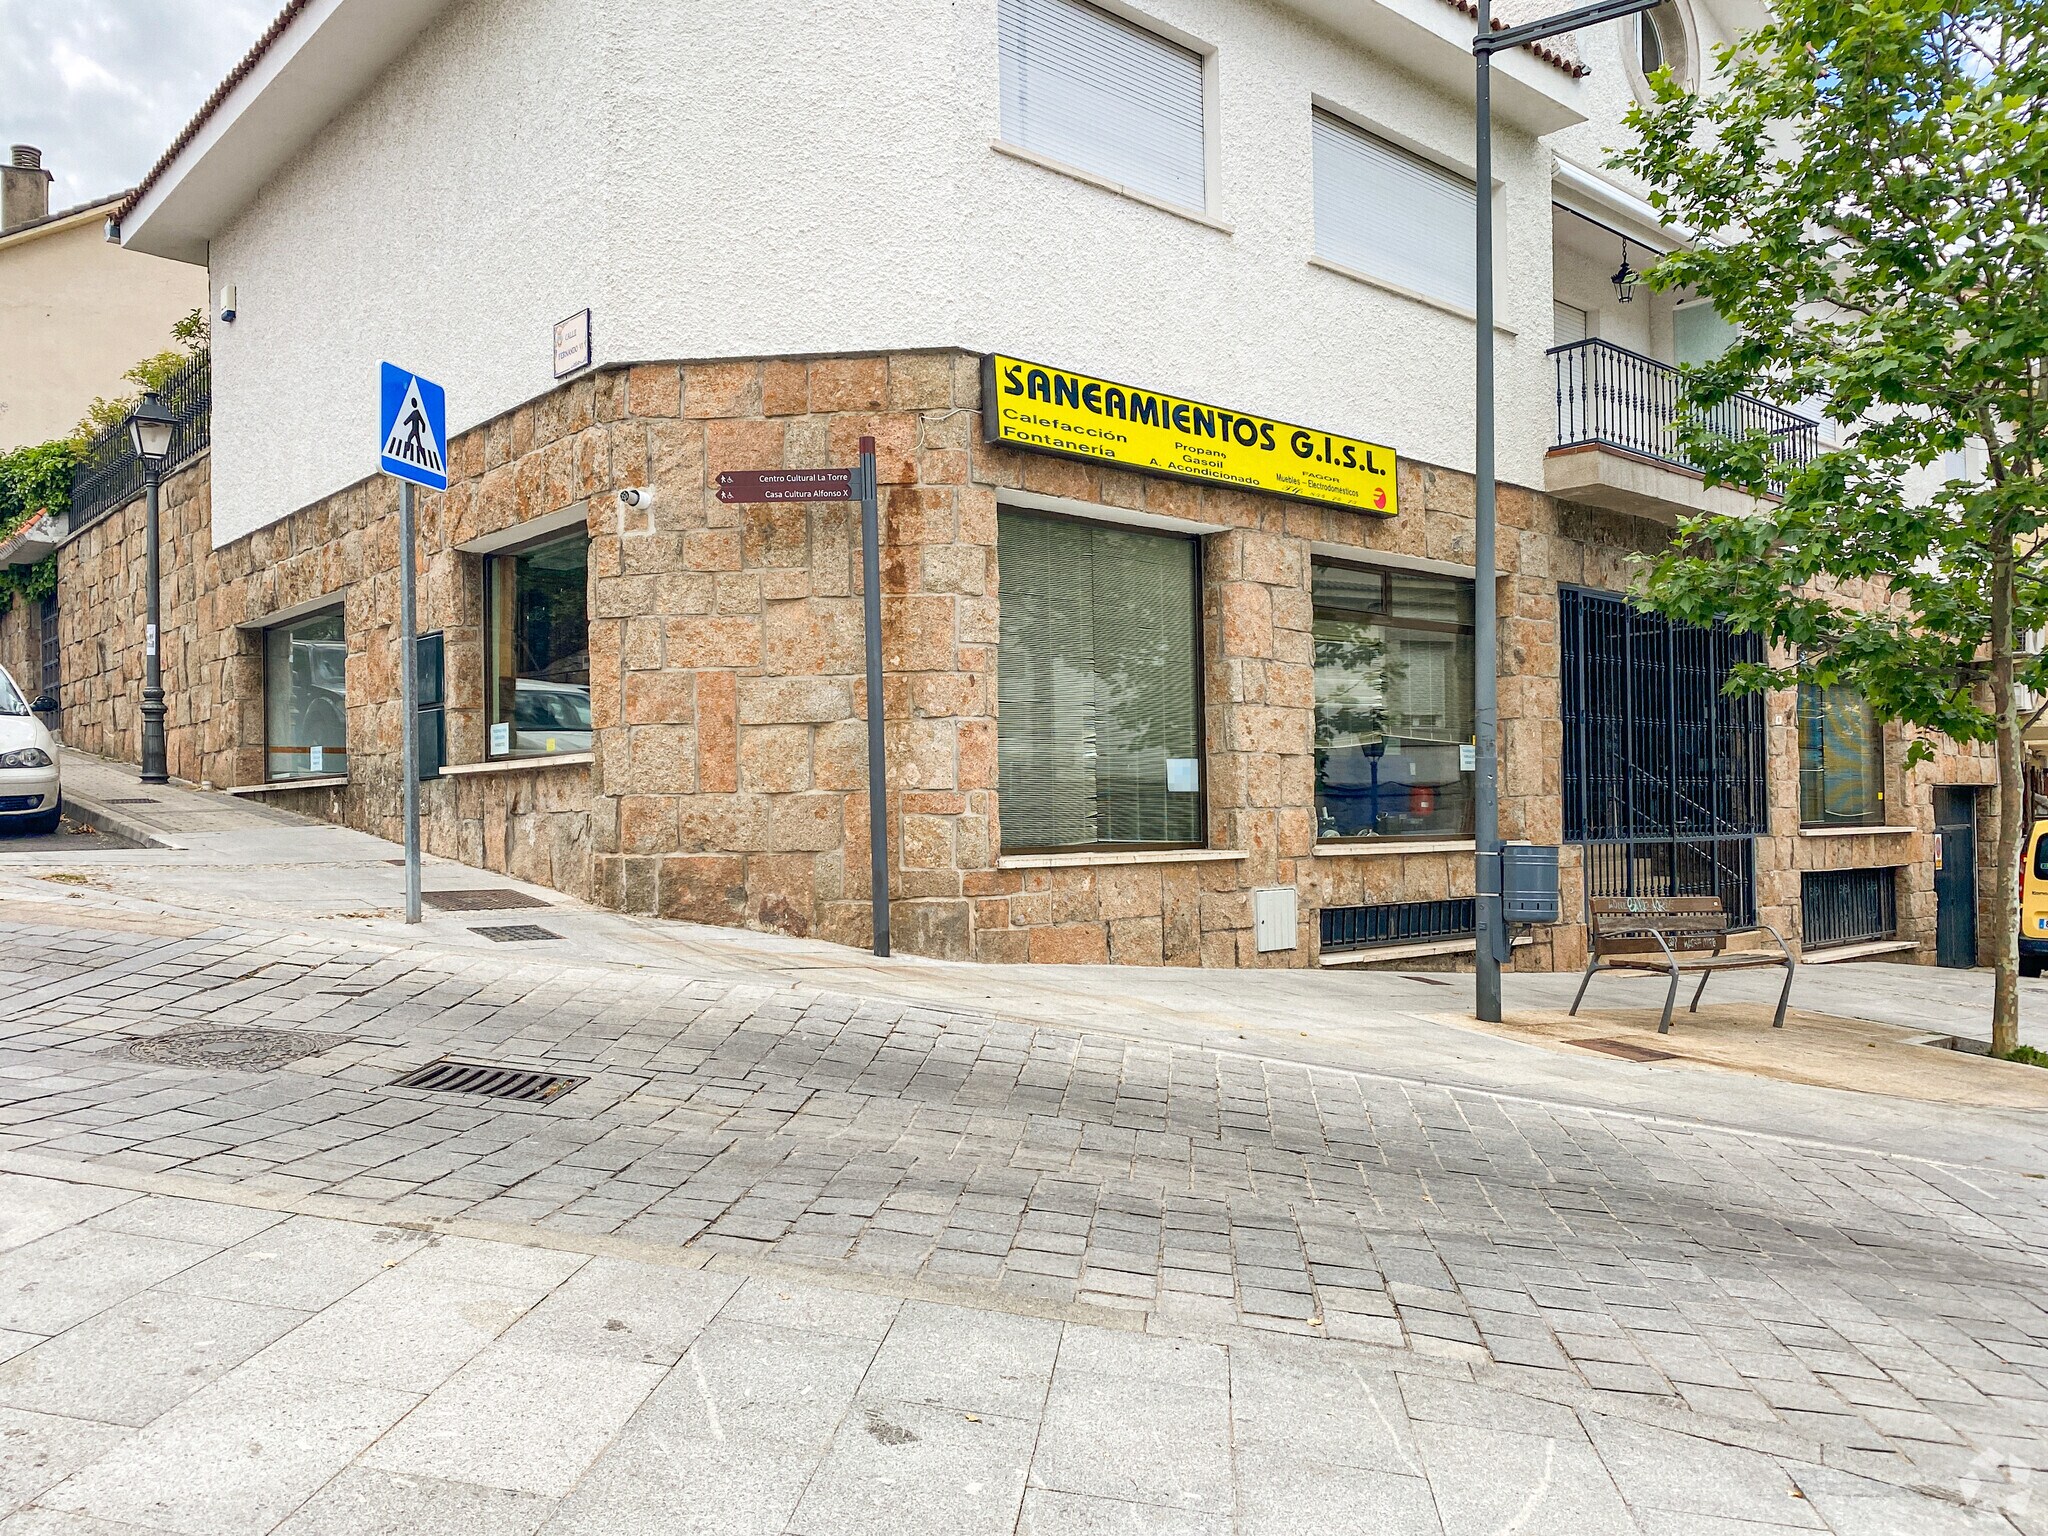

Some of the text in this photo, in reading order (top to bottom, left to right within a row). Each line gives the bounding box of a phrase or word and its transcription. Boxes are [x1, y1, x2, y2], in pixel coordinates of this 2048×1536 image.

[1003, 408, 1127, 443] Calefacción
[1004, 364, 1386, 476] SANEAMIENTOS G.I.S.L.
[1004, 426, 1116, 457] Fontanería
[1182, 454, 1223, 468] Gasoil
[759, 473, 848, 483] Centro Cultural La Torre
[1150, 458, 1260, 485] A. Acondicionado
[1302, 471, 1340, 484] FAGOR
[1276, 473, 1300, 486] Muebles
[764, 490, 783, 498] Casa
[784, 490, 812, 498] Cultura
[813, 490, 842, 498] Alfonso
